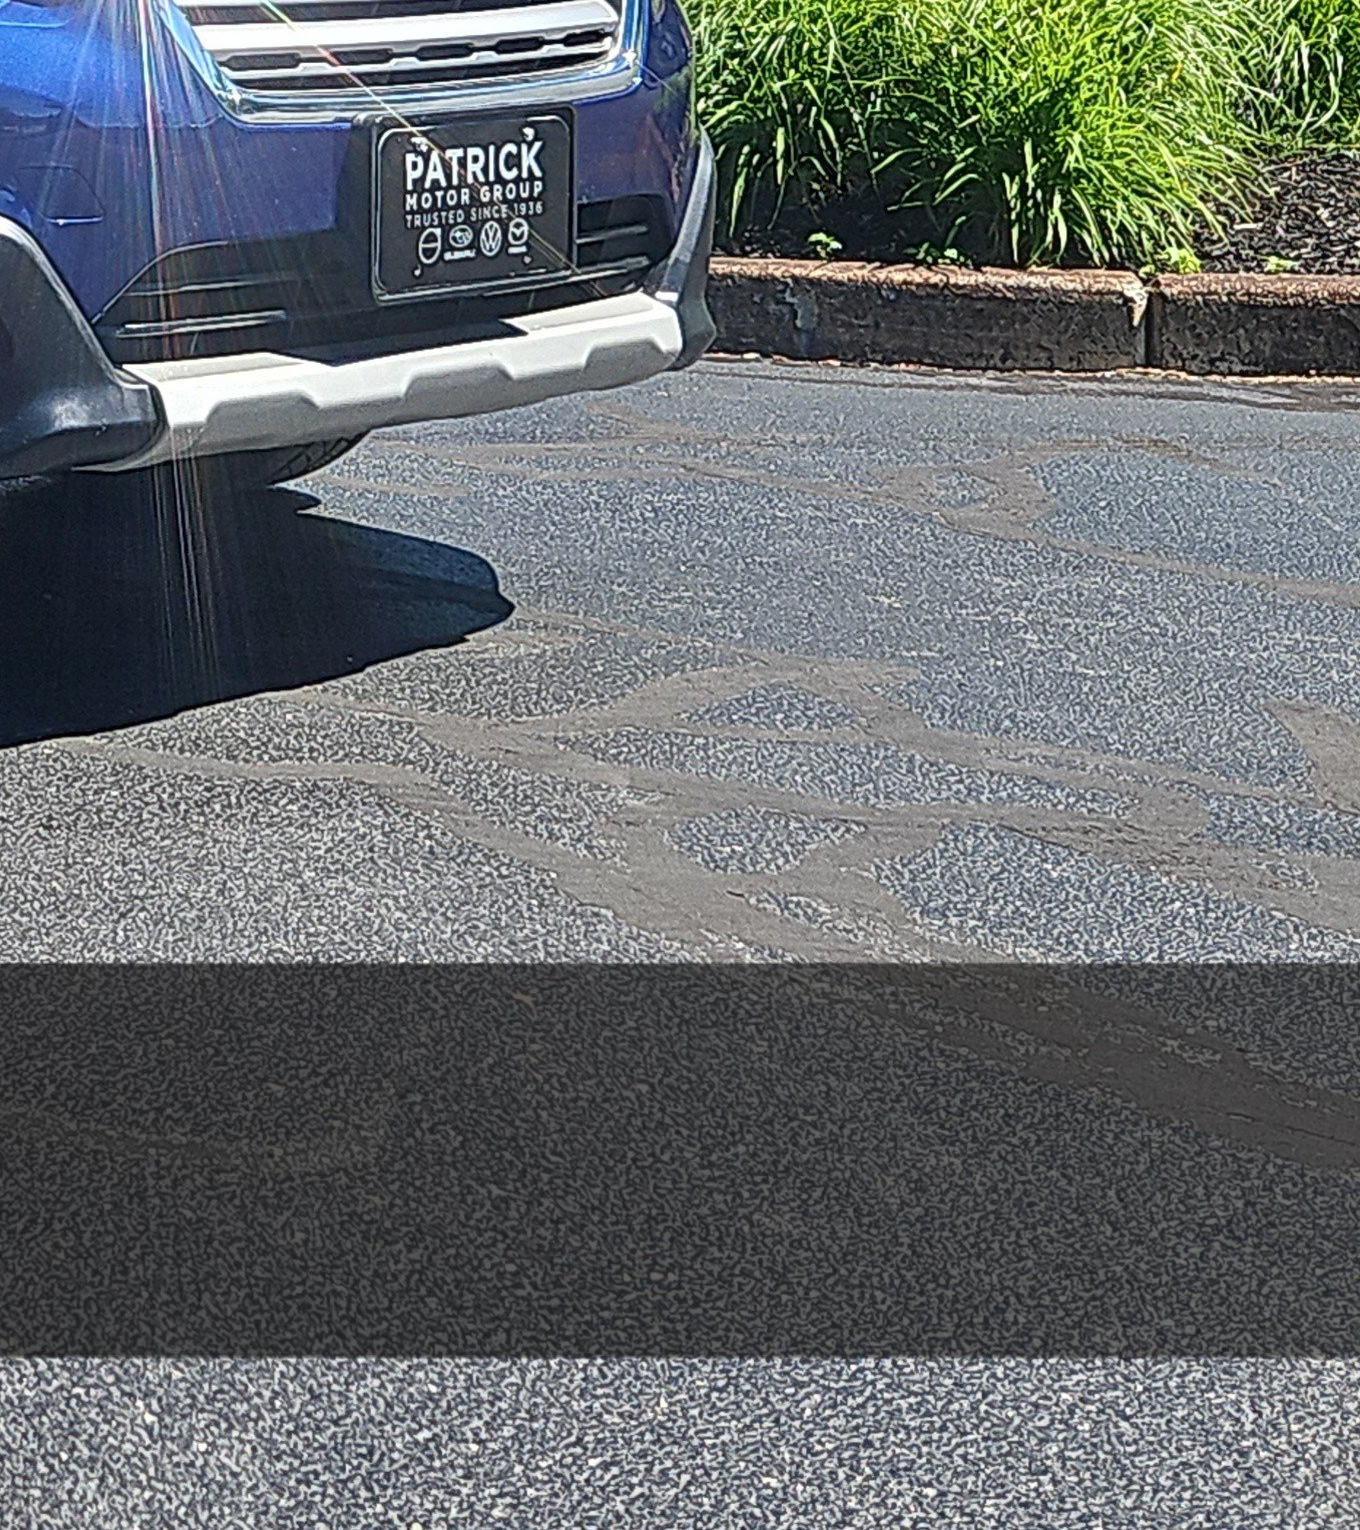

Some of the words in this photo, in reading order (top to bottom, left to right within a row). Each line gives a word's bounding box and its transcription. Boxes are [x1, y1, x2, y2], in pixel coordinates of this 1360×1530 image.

[405, 141, 543, 190] PATRICK
[405, 188, 470, 211] MOTOR
[480, 181, 543, 202] GROUP
[405, 209, 465, 228] TRUSTED
[470, 205, 509, 221] SINCE
[513, 201, 543, 216] 1936
